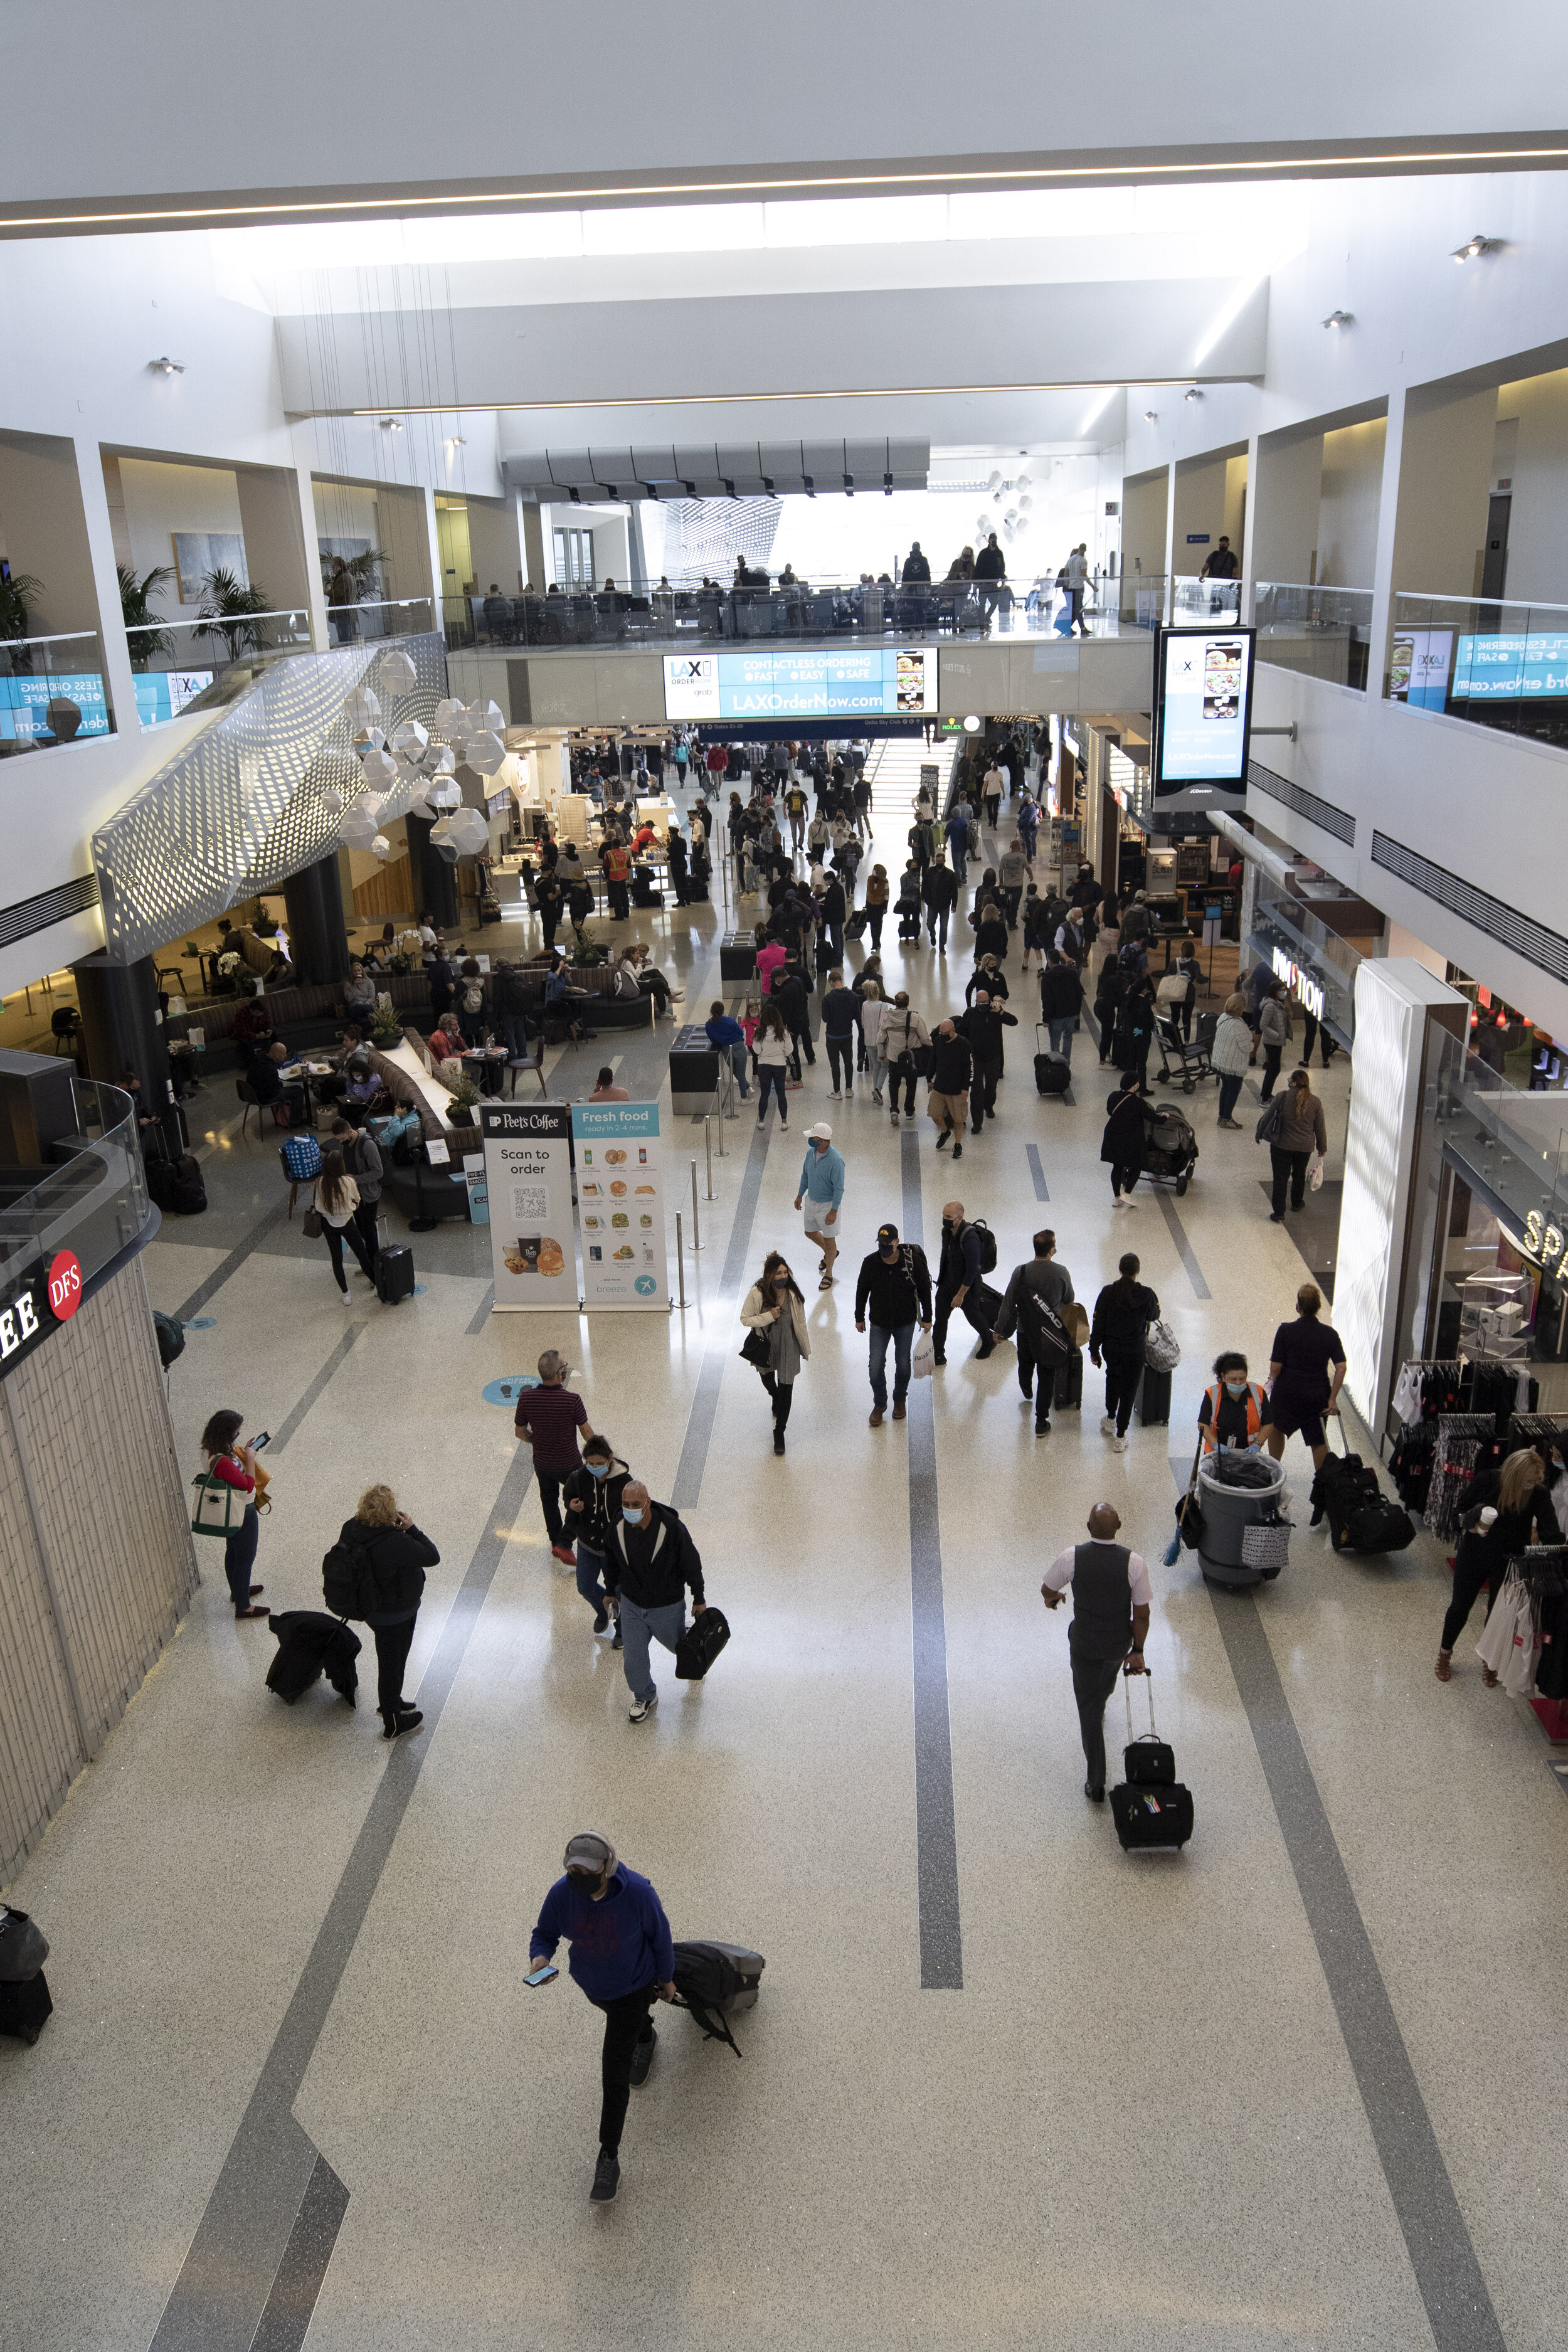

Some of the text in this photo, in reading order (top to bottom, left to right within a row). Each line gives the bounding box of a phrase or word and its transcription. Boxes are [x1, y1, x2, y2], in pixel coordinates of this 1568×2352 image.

[670, 661, 701, 677] LAX
[743, 657, 871, 670] CONTACTLESS ORDERING
[755, 671, 778, 681] FAST
[800, 670, 824, 681] EASY
[847, 669, 870, 679] SAFE
[694, 689, 712, 697] grab
[733, 693, 882, 711] LAXOrderNow.com
[502, 1114, 559, 1130] Peet's Coffee
[583, 1110, 649, 1122] Fresh food
[501, 1149, 549, 1159] Scan to
[511, 1163, 545, 1174] order
[51, 1264, 80, 1308] DFS
[1033, 1294, 1062, 1328] HEAD
